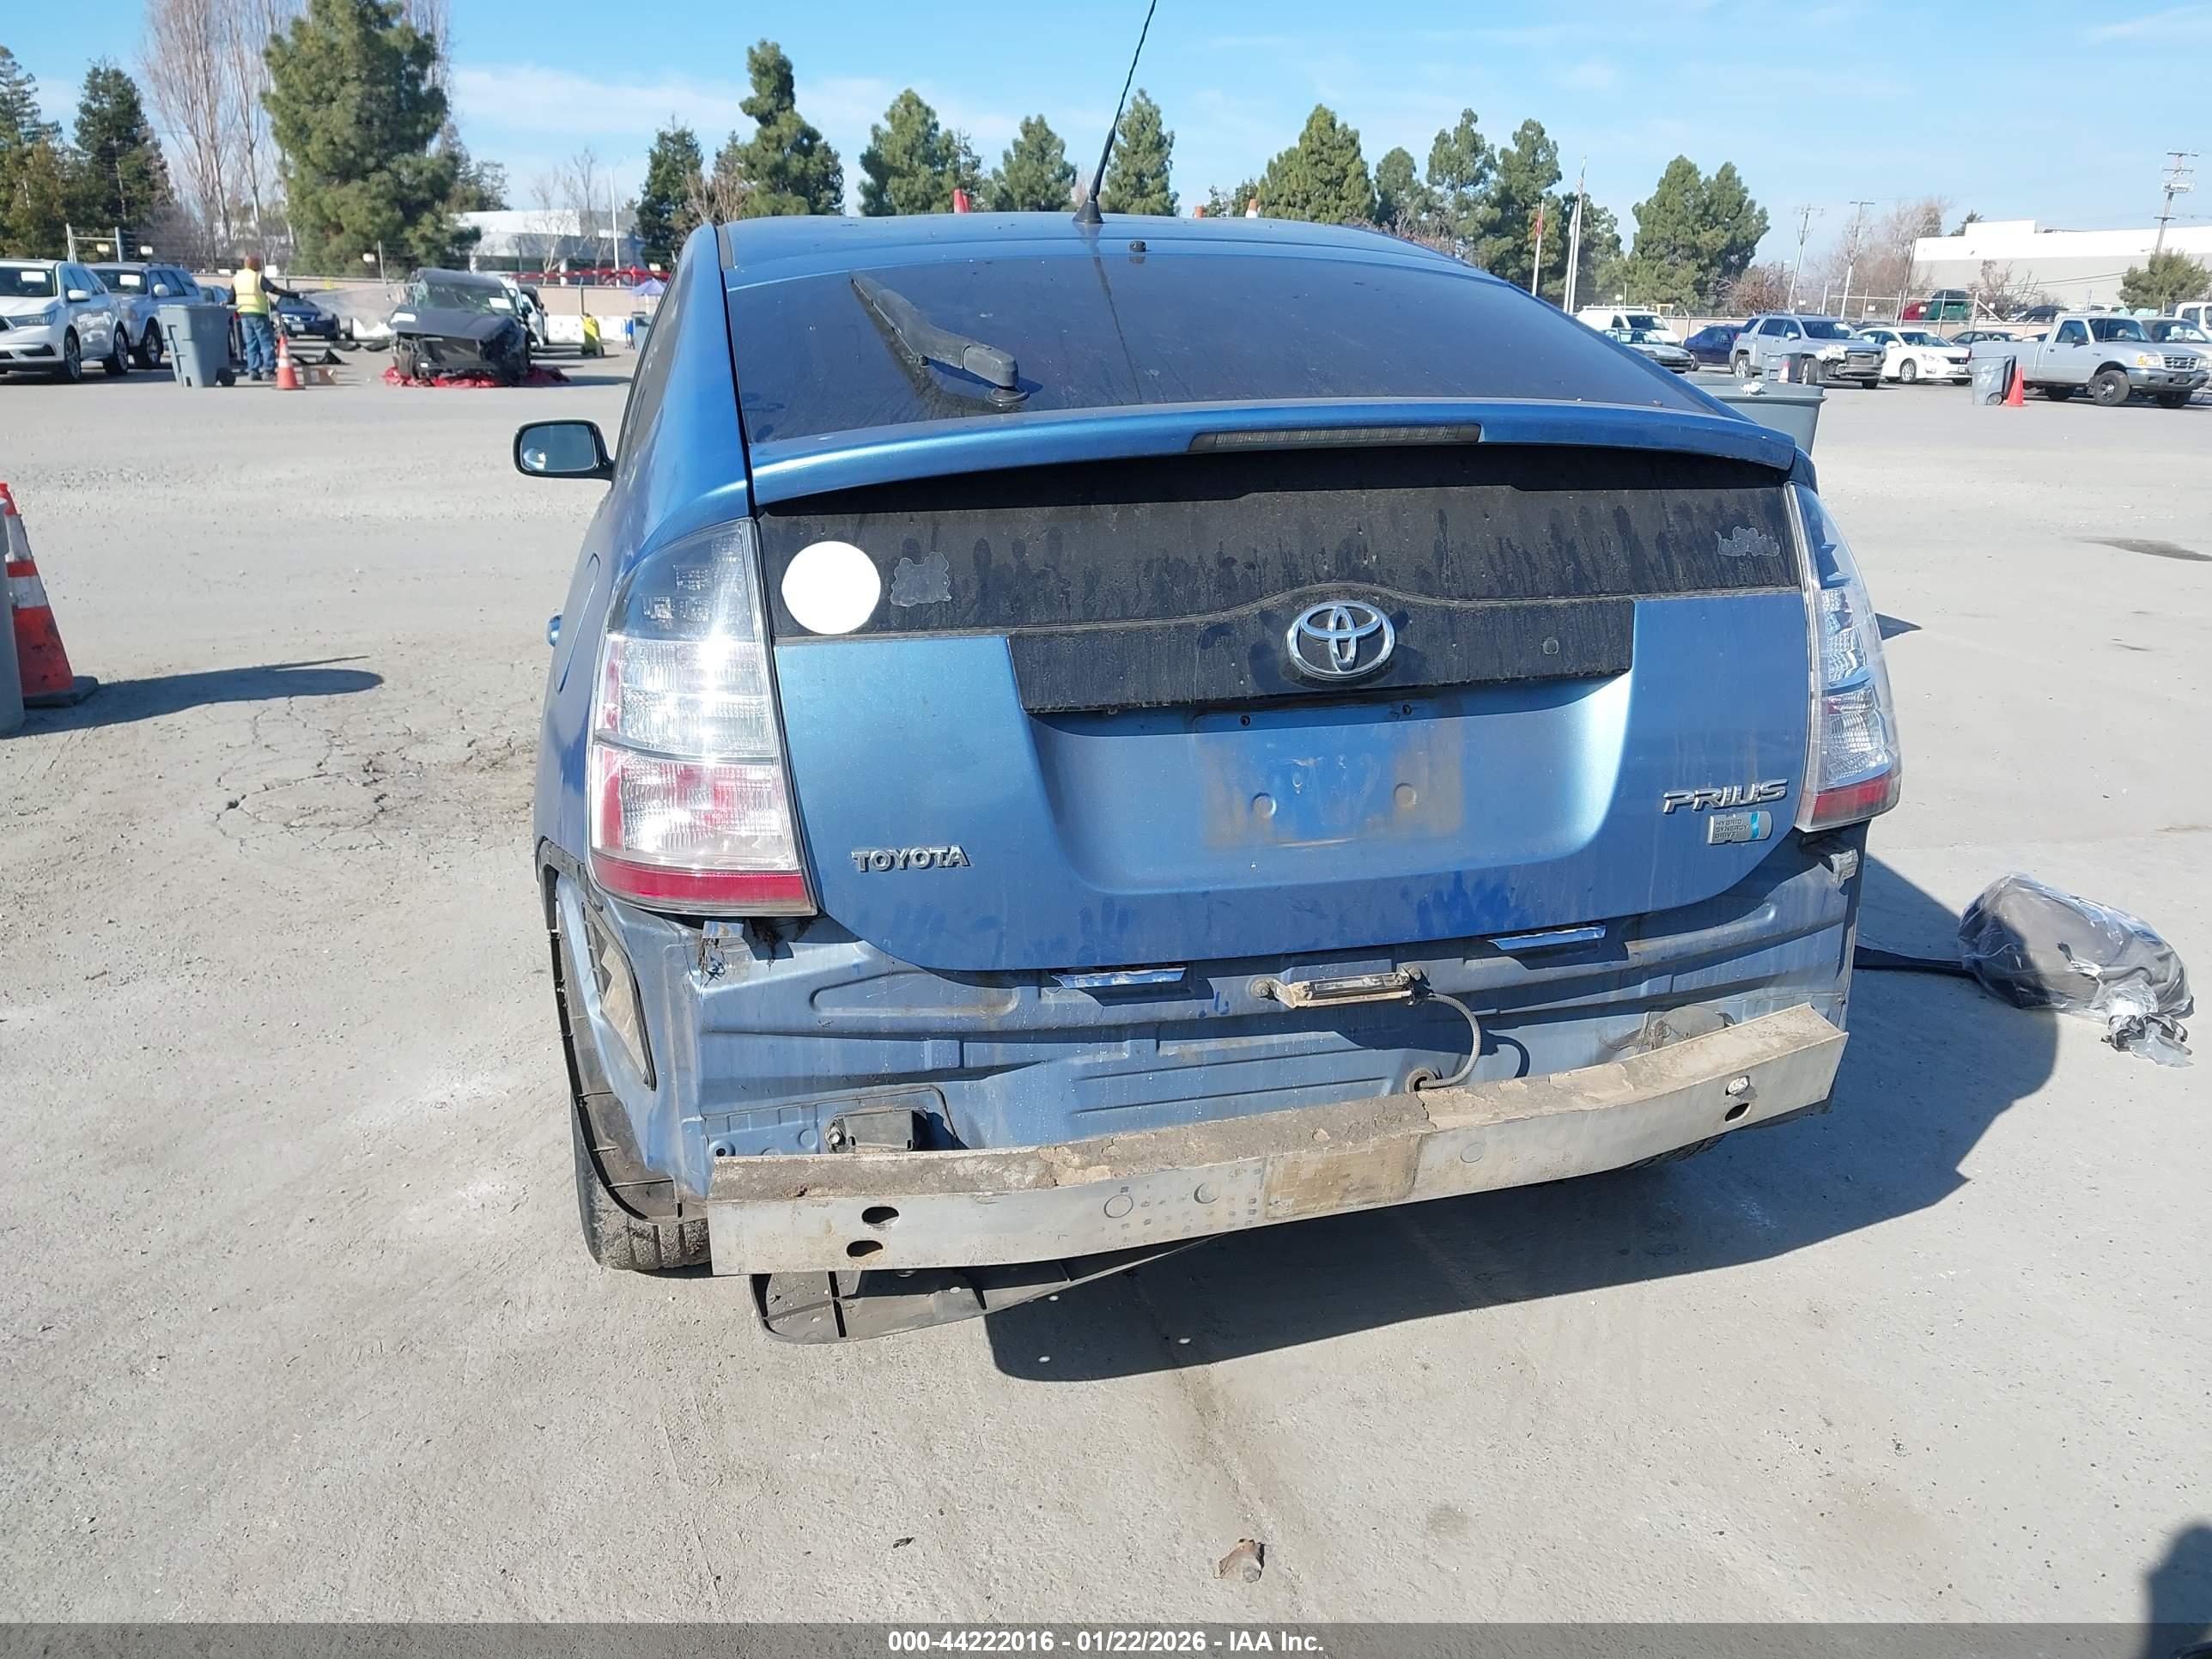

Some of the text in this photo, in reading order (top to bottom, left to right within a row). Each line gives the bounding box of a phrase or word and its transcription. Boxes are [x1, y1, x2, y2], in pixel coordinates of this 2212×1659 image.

[1662, 778, 1789, 815] PRIUS
[1716, 824, 1749, 833] SYNERGY
[851, 845, 970, 872] TOYOTA
